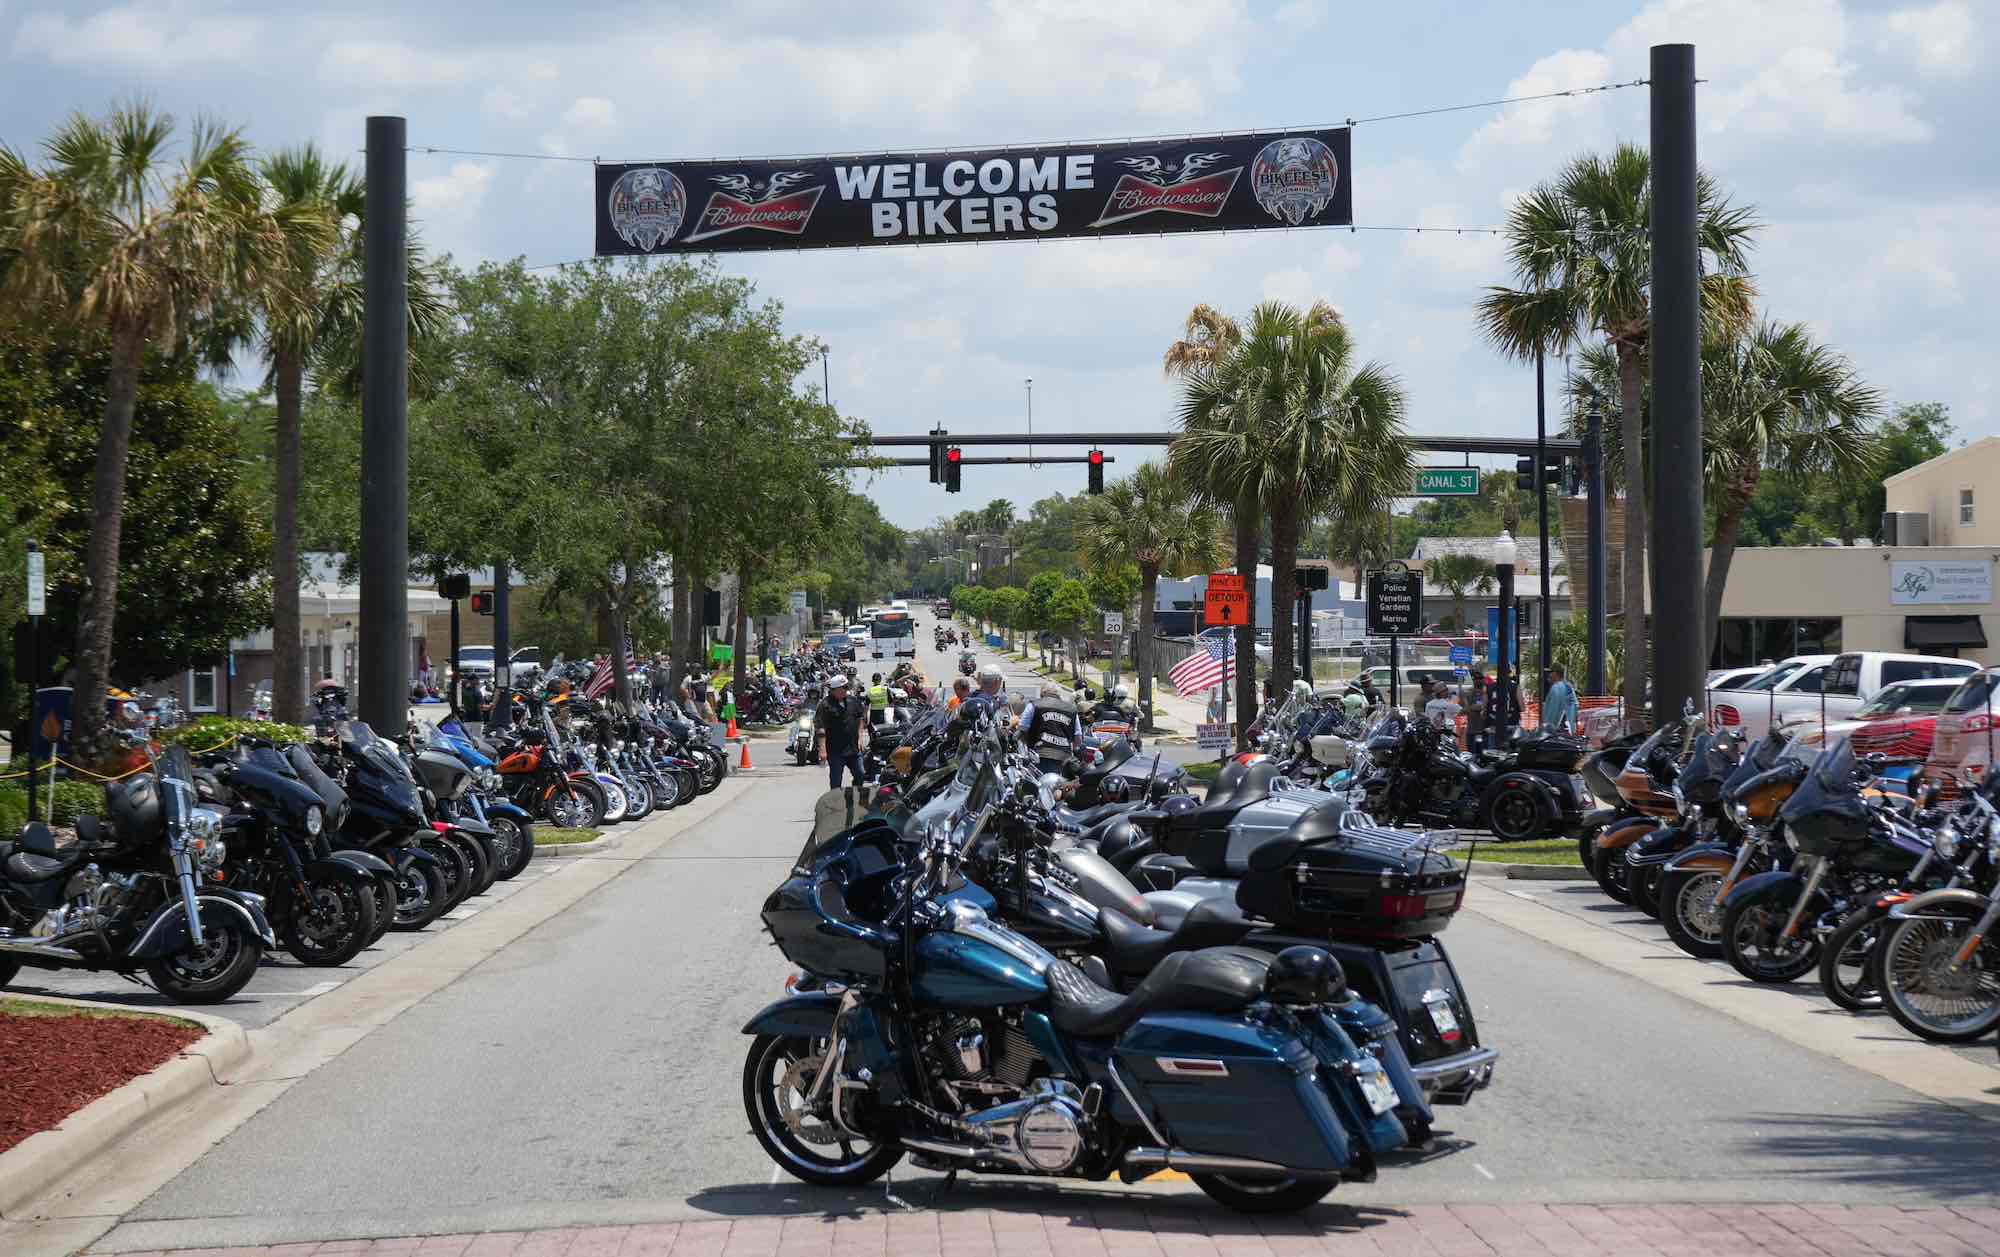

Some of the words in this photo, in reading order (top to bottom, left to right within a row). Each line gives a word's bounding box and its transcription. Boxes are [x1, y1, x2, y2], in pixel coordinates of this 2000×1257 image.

[834, 154, 1095, 200] WELCOME
[1259, 170, 1329, 188] BIKEFEST
[1113, 189, 1227, 209] Budweiser
[704, 206, 811, 225] Budweiser
[871, 193, 1059, 238] BIKERS
[1421, 475, 1457, 488] CANAL
[1460, 475, 1473, 488] ST
[1383, 583, 1407, 592] Police
[1208, 593, 1245, 602] DETOUR
[1379, 594, 1412, 603] Venetian
[1379, 603, 1411, 612] Gardens
[1106, 623, 1121, 632] 20
